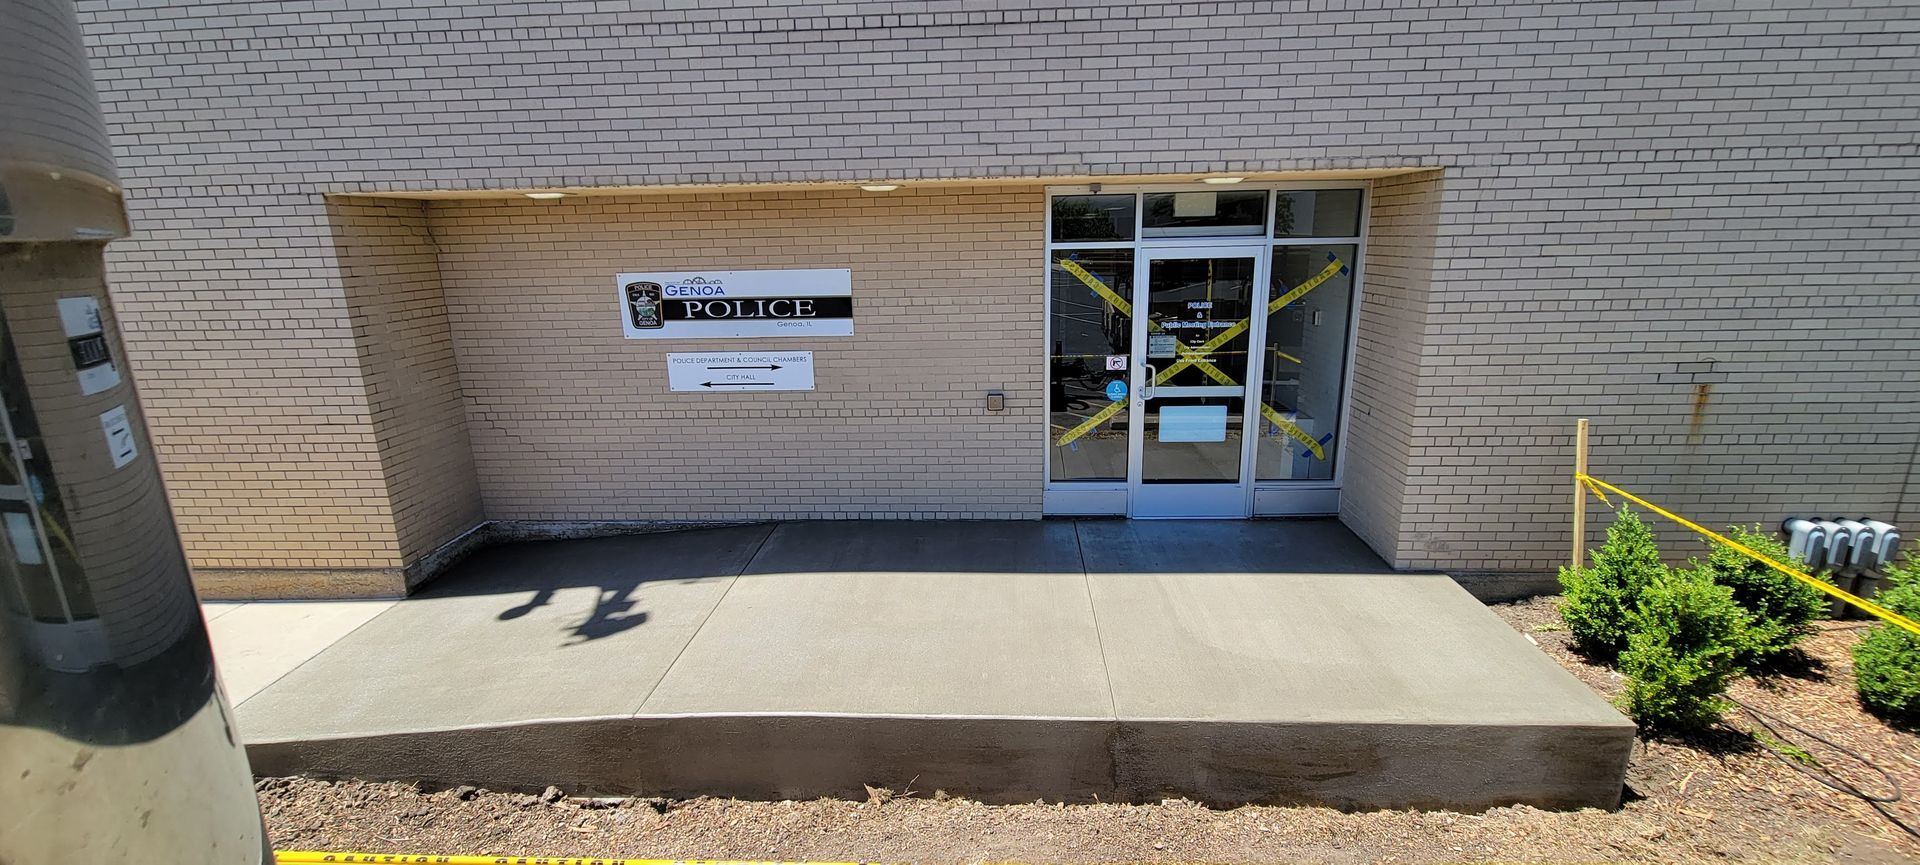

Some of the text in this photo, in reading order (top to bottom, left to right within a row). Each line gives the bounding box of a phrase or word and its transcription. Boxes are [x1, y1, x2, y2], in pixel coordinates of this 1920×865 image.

[665, 285, 725, 296] GENOA
[682, 299, 817, 319] POLICE
[1161, 321, 1181, 331] Public
[1182, 321, 1207, 329] Meeting
